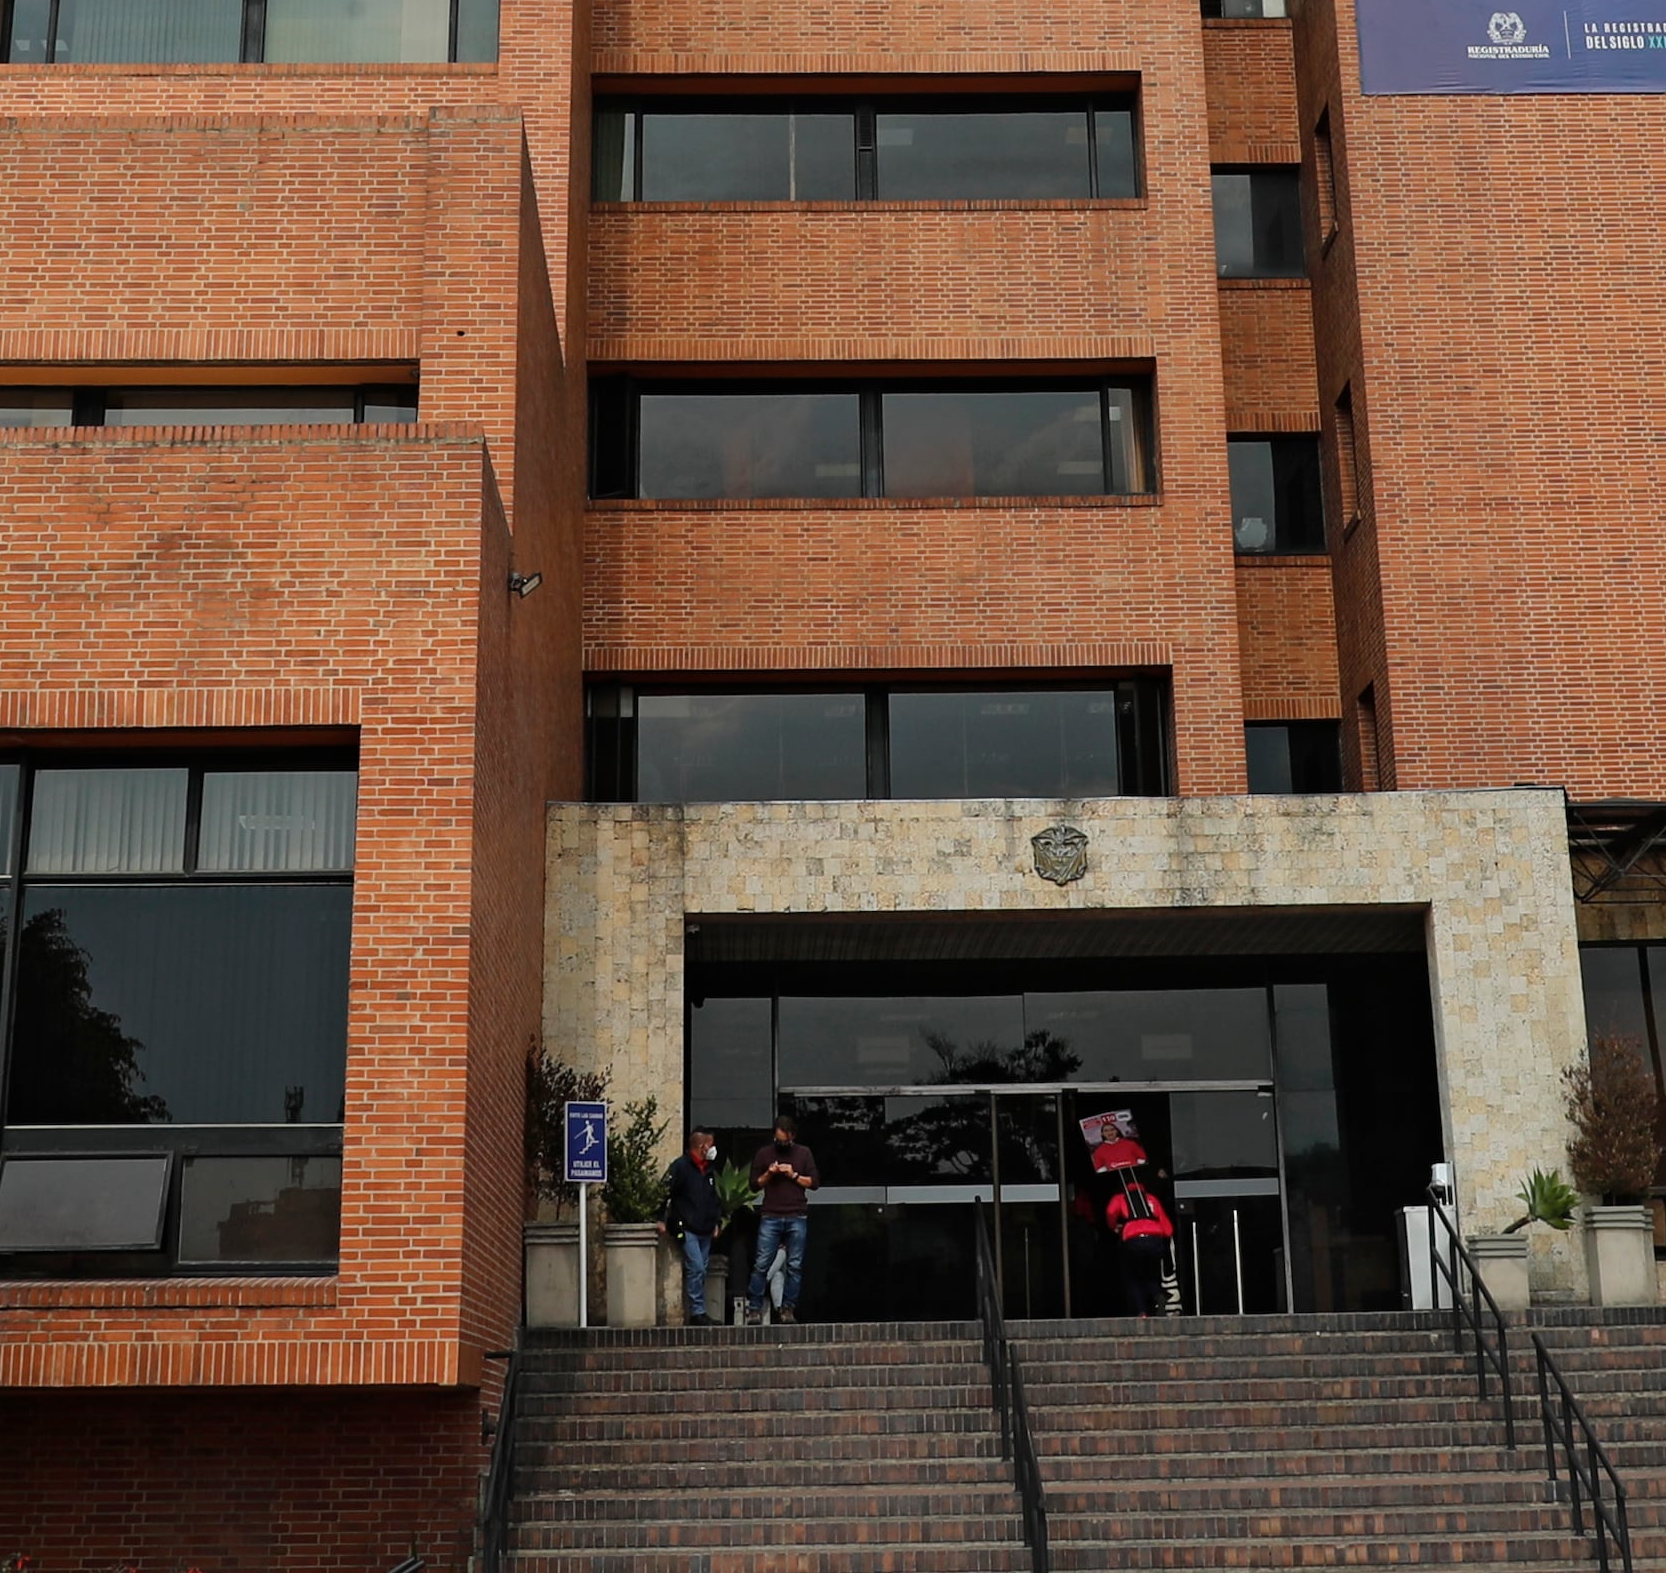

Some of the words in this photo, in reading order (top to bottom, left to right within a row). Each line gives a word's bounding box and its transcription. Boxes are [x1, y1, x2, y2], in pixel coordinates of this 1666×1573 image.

[1584, 23, 1598, 34] LA
[1586, 36, 1609, 50] DEL
[1609, 35, 1645, 49] SIGLO
[1467, 43, 1550, 54] REGISTRADURÍA
